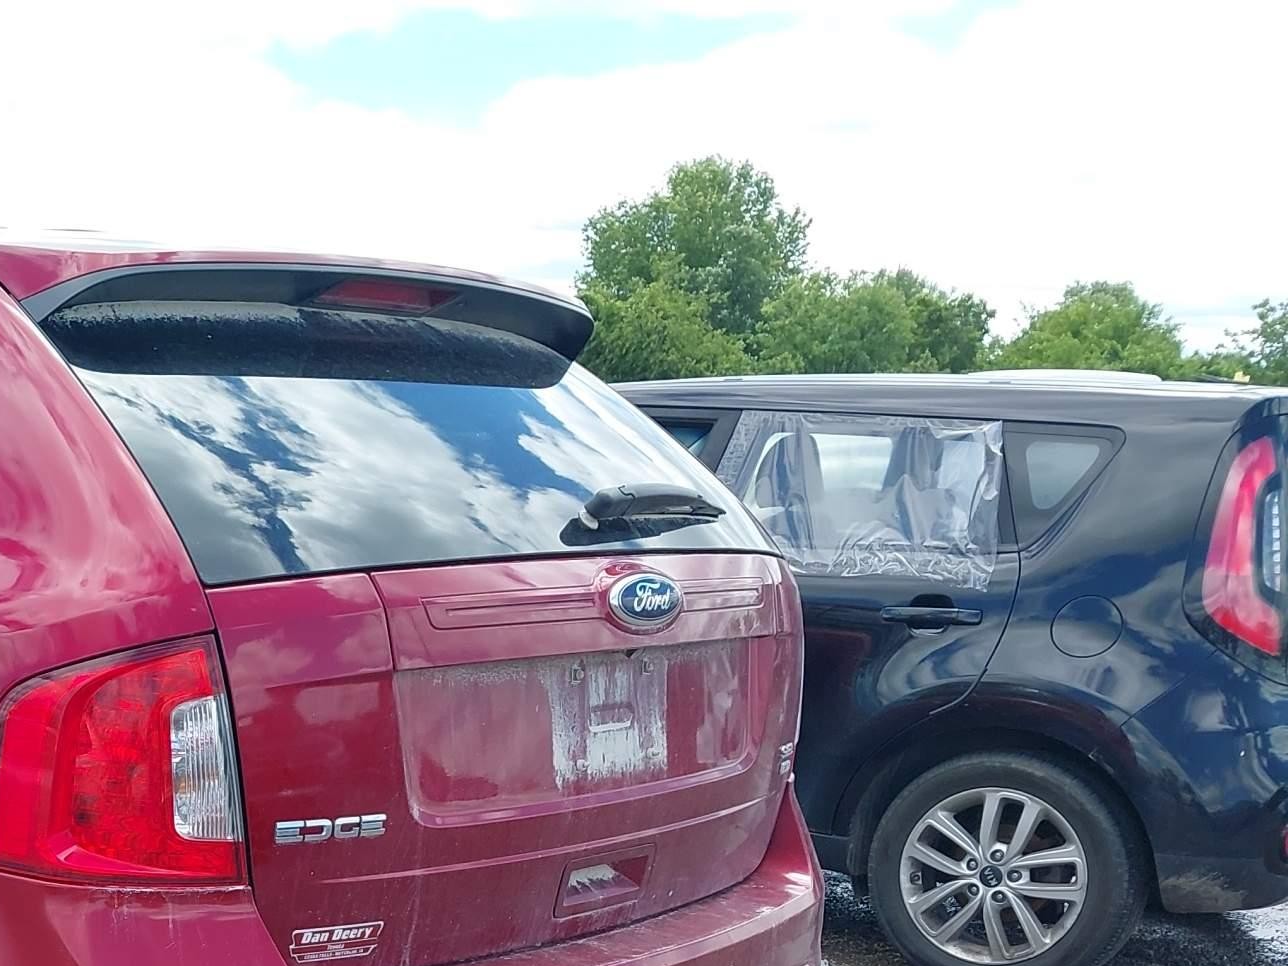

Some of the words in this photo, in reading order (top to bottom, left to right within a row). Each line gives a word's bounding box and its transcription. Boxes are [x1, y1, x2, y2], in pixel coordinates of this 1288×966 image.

[633, 582, 672, 612] Ford
[275, 813, 387, 845] EDGE
[301, 932, 329, 944] Dan
[332, 927, 374, 941] Deery
